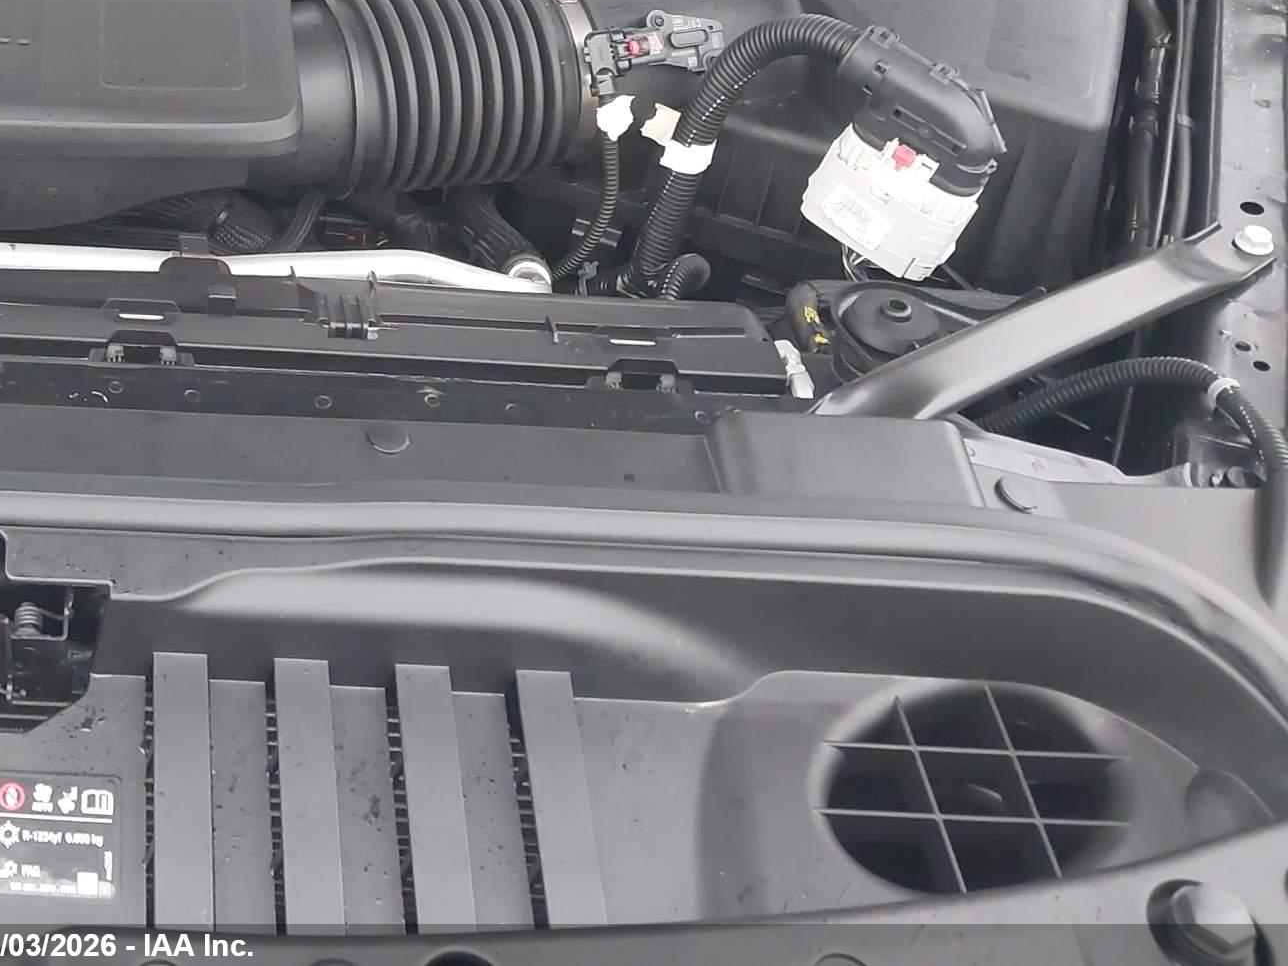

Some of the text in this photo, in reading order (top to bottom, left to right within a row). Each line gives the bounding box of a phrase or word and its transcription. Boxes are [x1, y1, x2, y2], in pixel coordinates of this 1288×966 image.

[22, 830, 63, 845] R-1234yf
[91, 833, 104, 847] kg
[21, 864, 41, 878] PAG
